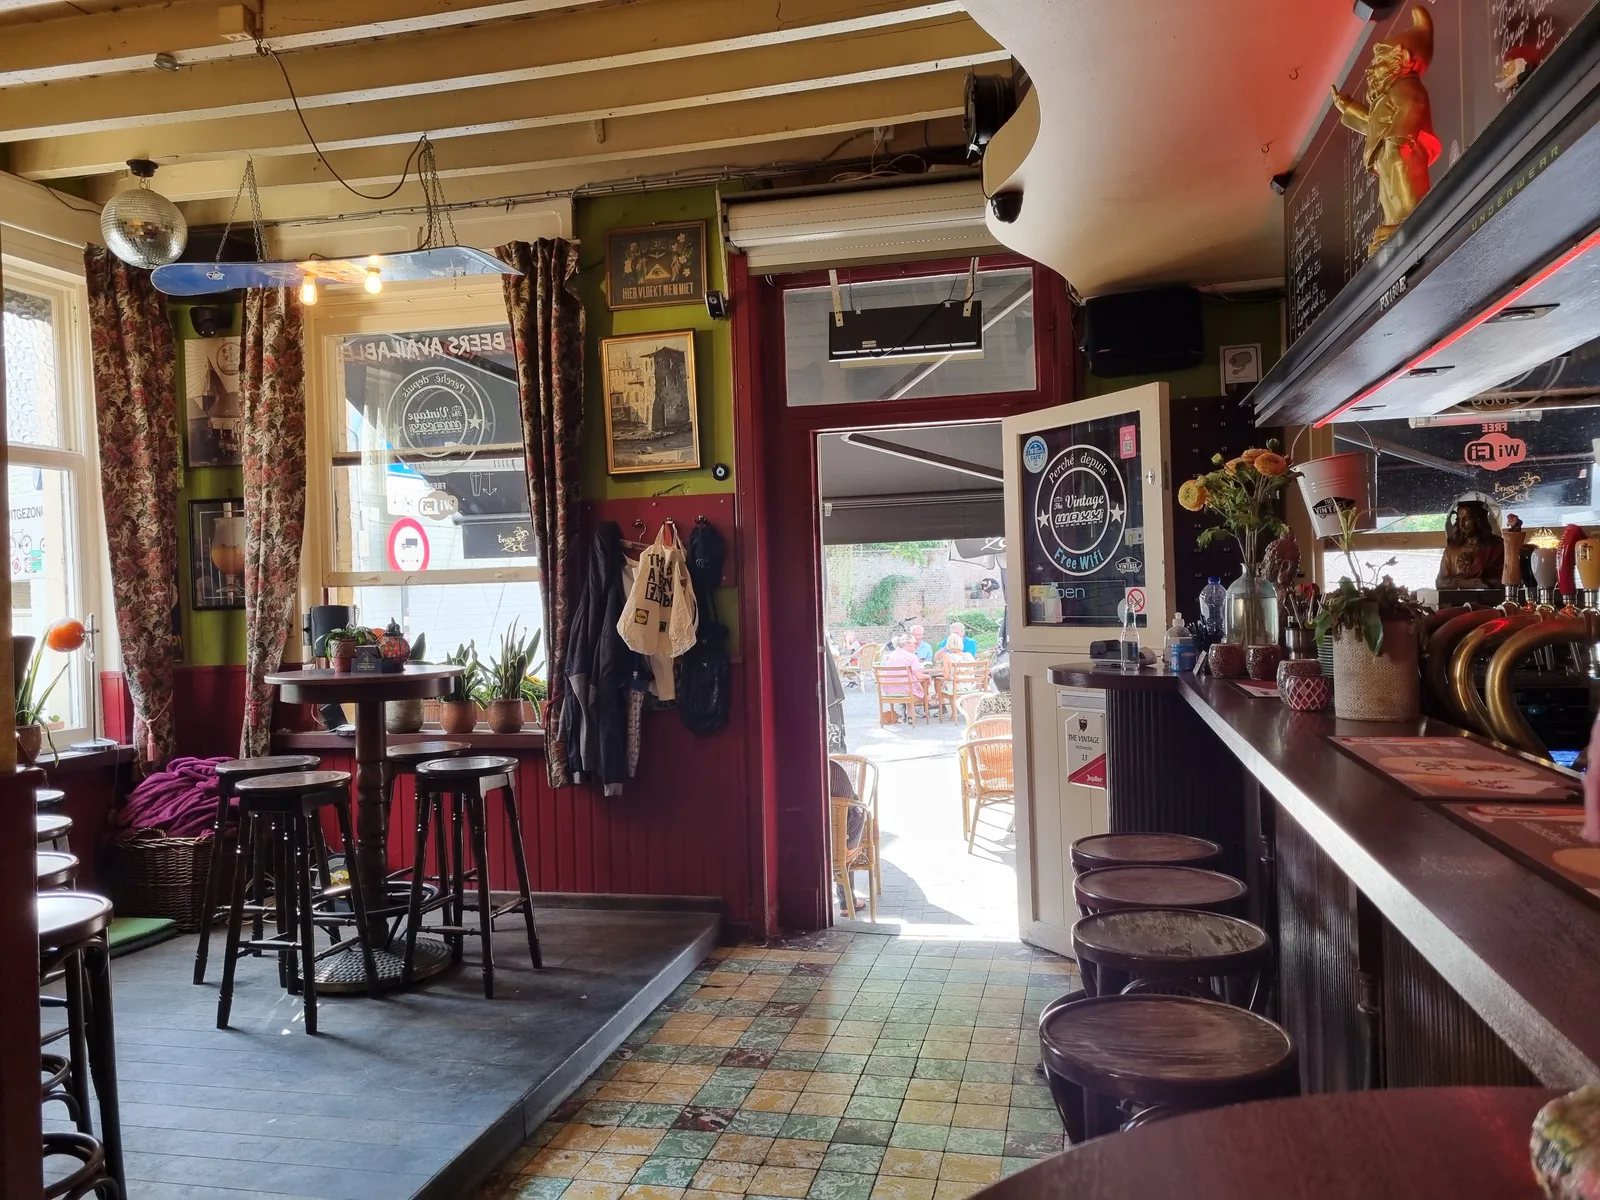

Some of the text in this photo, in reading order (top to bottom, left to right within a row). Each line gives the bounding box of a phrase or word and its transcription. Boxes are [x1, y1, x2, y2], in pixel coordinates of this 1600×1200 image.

[1471, 145, 1559, 231] UNDERWEAR
[622, 282, 694, 300] HIER VLOEKT MEN NIET
[1049, 452, 1108, 484] Perché depuis
[1065, 494, 1104, 508] Vintage
[1054, 547, 1104, 570] Free Wifi
[1068, 734, 1100, 744] THE VINTAGE
